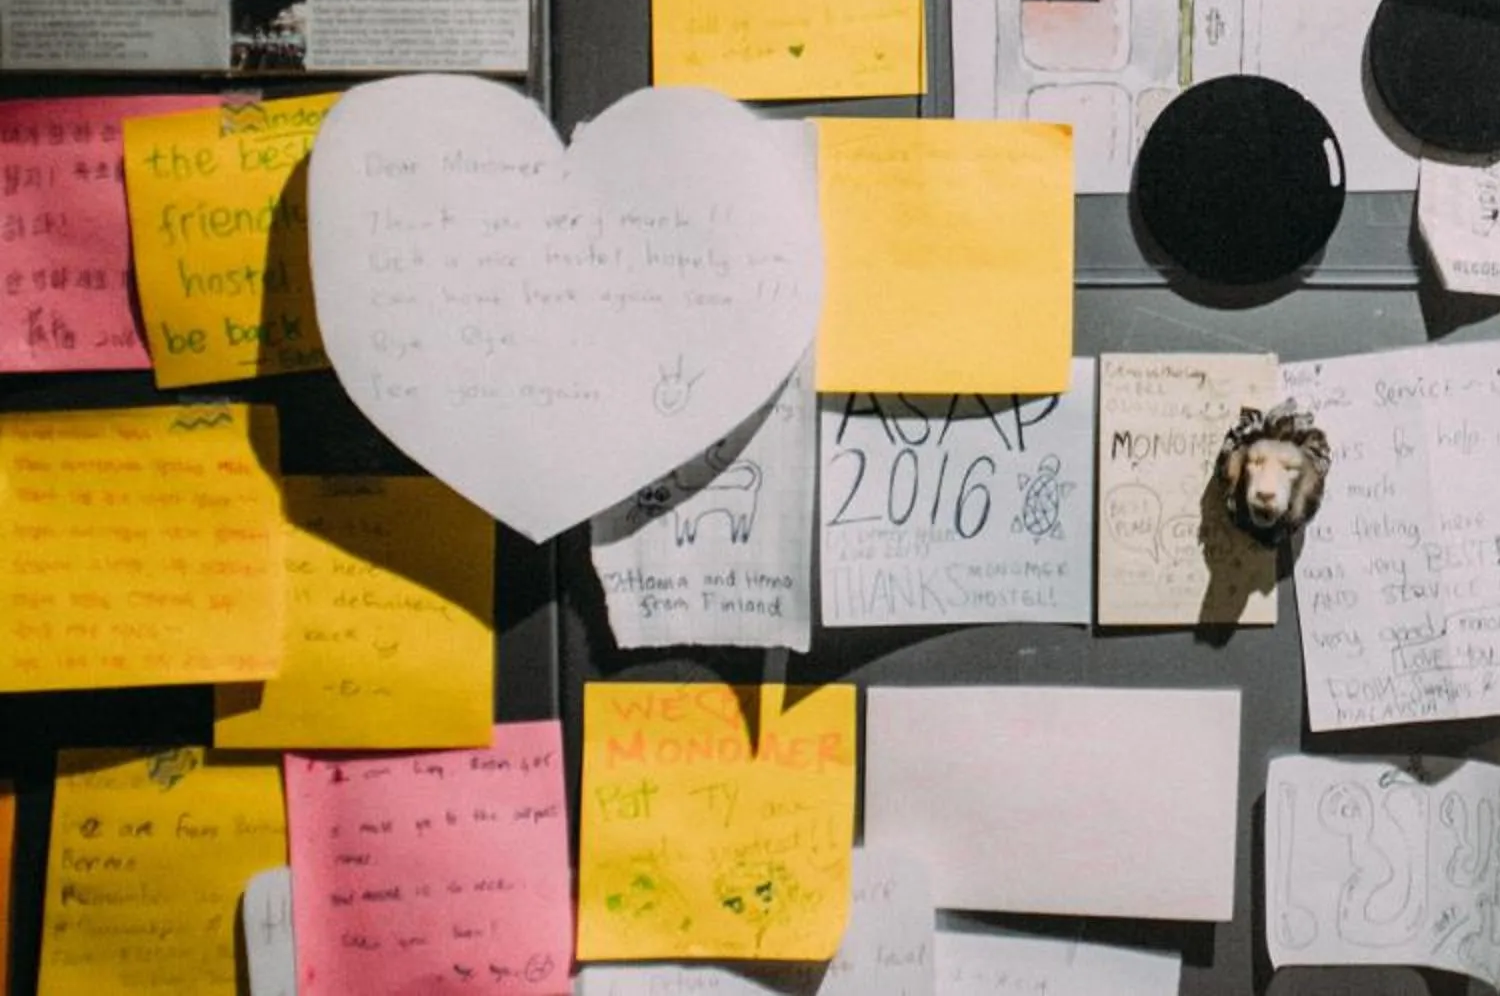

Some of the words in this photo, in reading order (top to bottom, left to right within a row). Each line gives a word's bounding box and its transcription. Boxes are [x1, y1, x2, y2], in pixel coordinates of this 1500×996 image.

[143, 143, 220, 180] the
[161, 319, 208, 355] be
[835, 393, 1062, 454] ASAP
[1111, 429, 1225, 461] MONOME
[826, 447, 998, 541] 2016
[703, 571, 738, 588] and
[832, 561, 968, 621] THANKS
[639, 593, 690, 620] from
[701, 591, 784, 617] Finland
[606, 730, 853, 774] MONOMER
